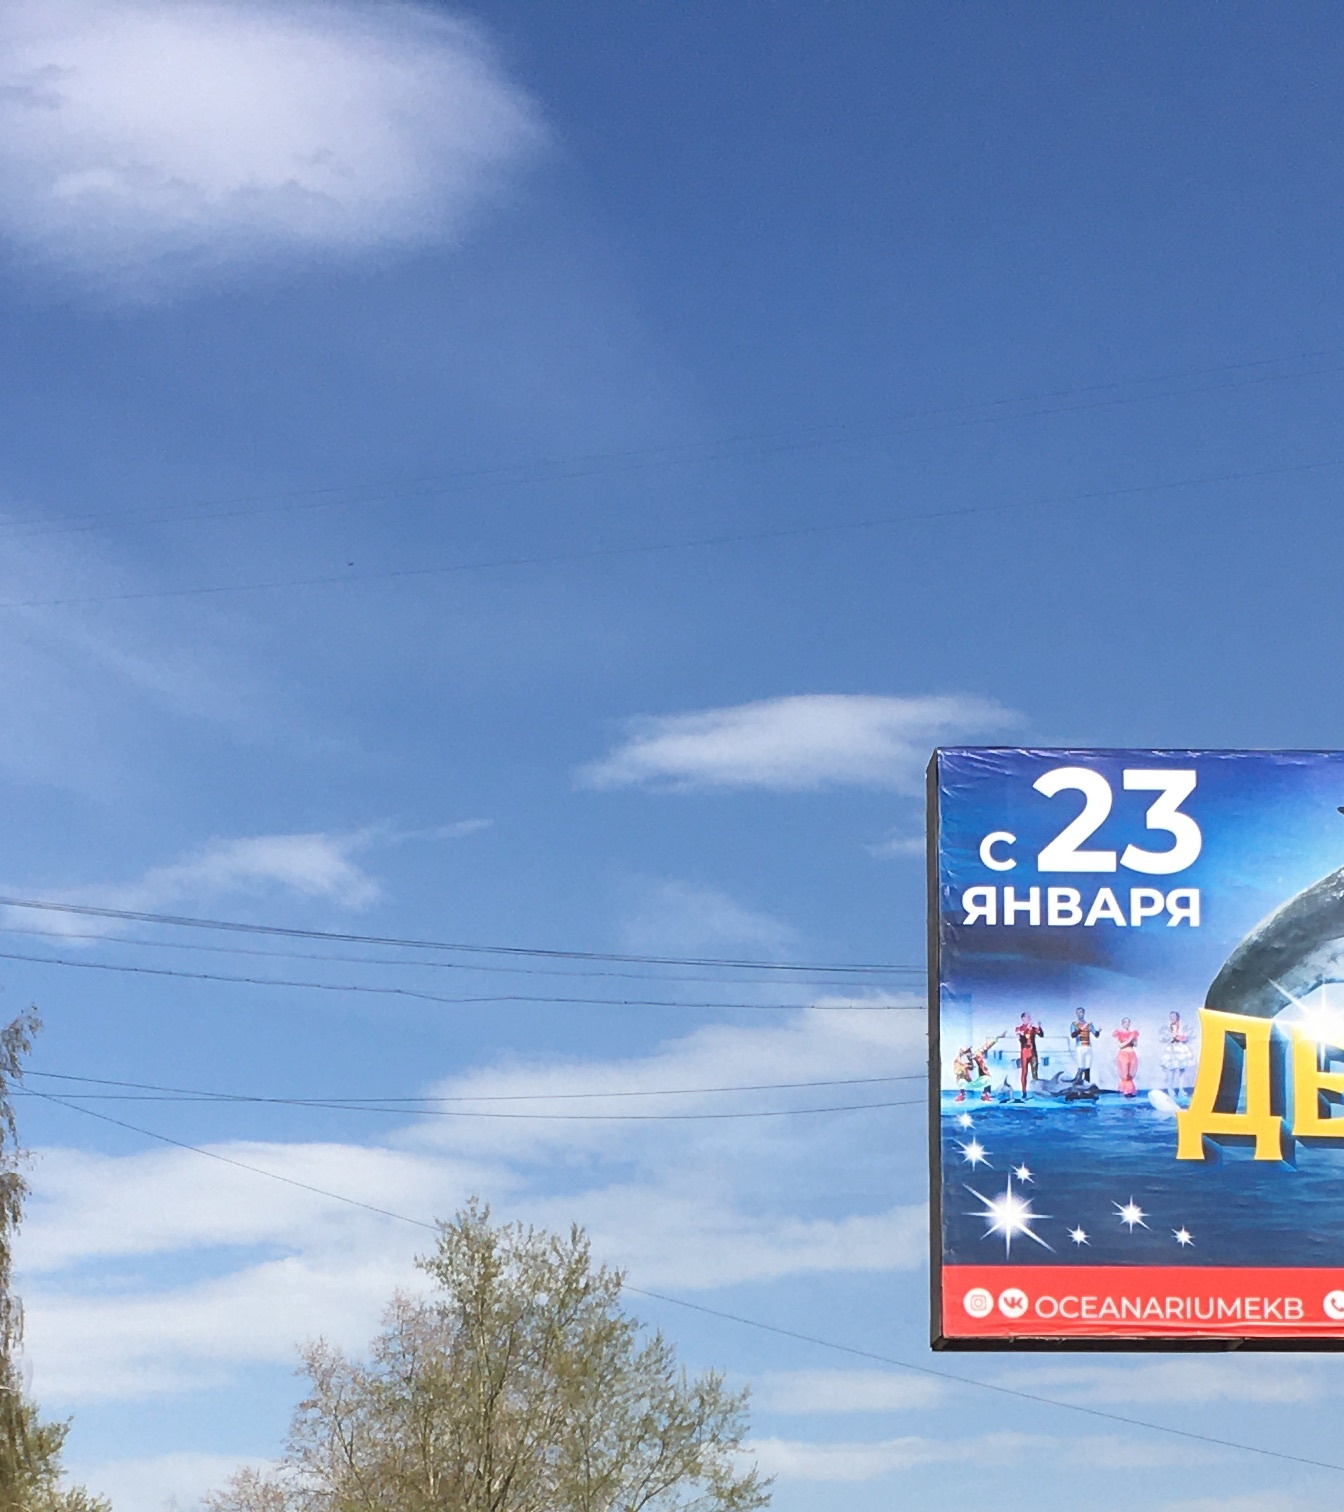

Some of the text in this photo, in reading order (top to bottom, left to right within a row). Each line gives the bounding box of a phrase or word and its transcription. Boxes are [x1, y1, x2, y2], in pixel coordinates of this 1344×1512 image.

[1032, 766, 1203, 875] 23
[961, 886, 1201, 927] ЯНВАРЯ
[1034, 1295, 1305, 1320] OCEANARIUMEKB
